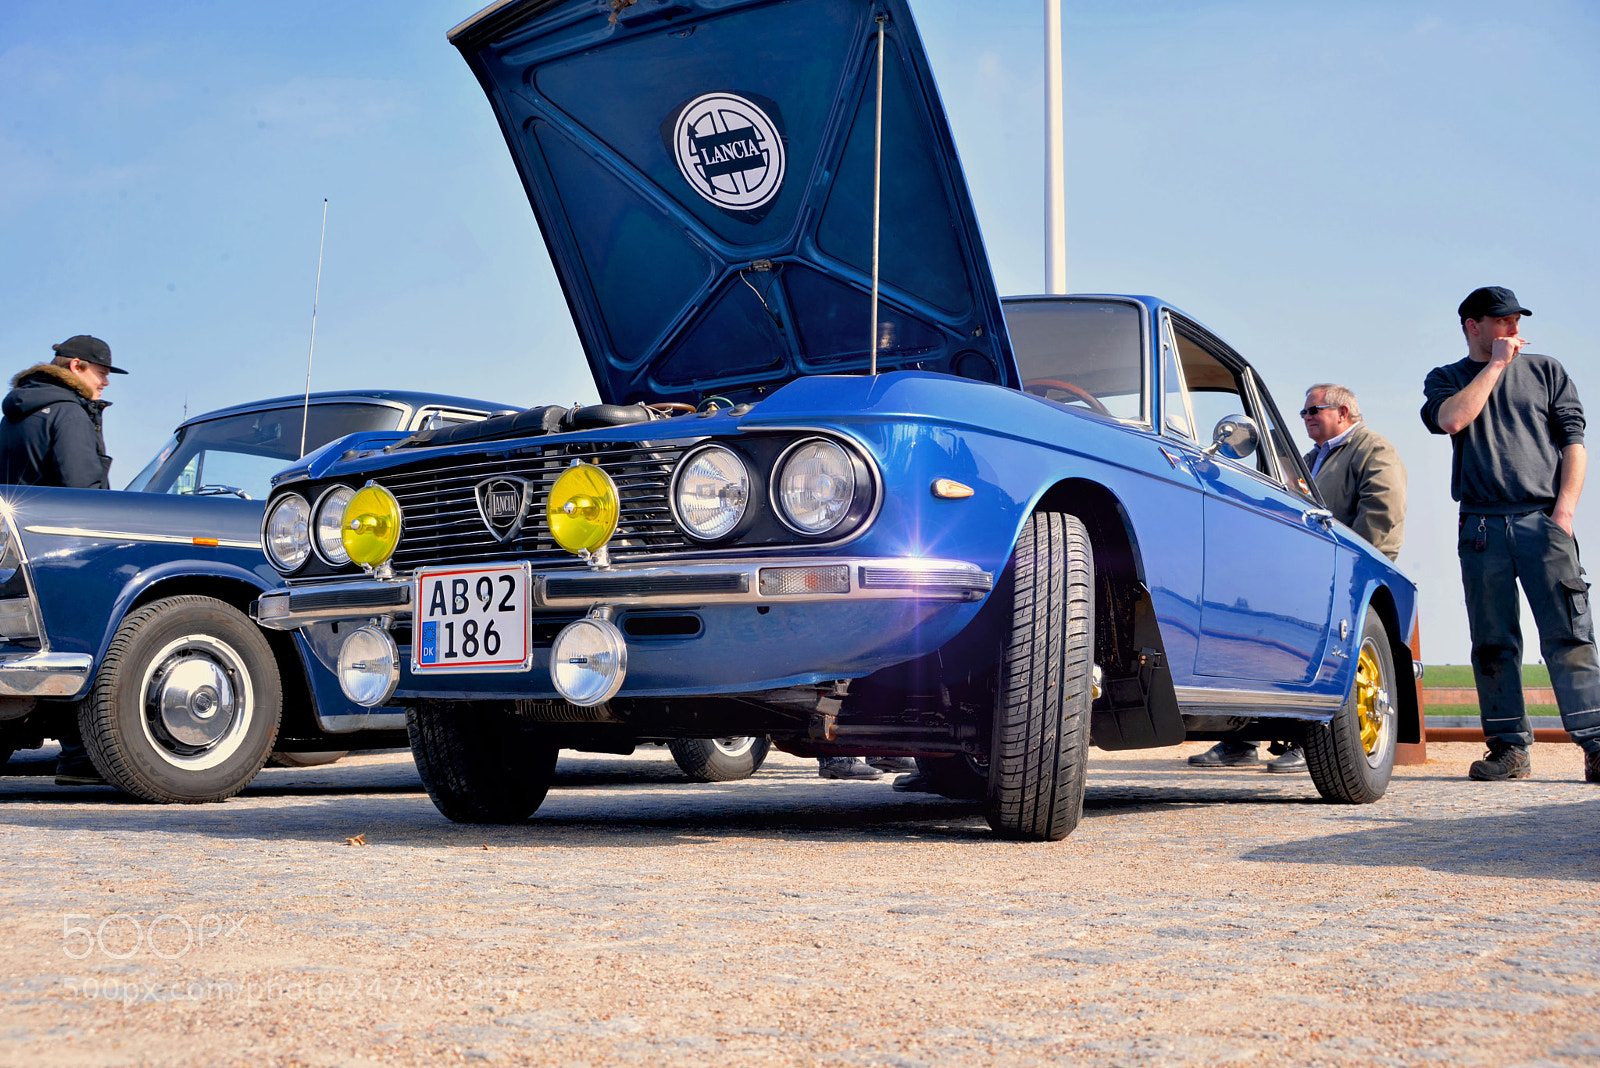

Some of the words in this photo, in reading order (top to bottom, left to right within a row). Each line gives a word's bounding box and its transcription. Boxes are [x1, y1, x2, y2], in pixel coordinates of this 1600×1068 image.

[700, 138, 761, 166] LANCIA
[493, 494, 516, 516] LANCIA
[423, 646, 434, 657] DK
[444, 619, 501, 659] 186
